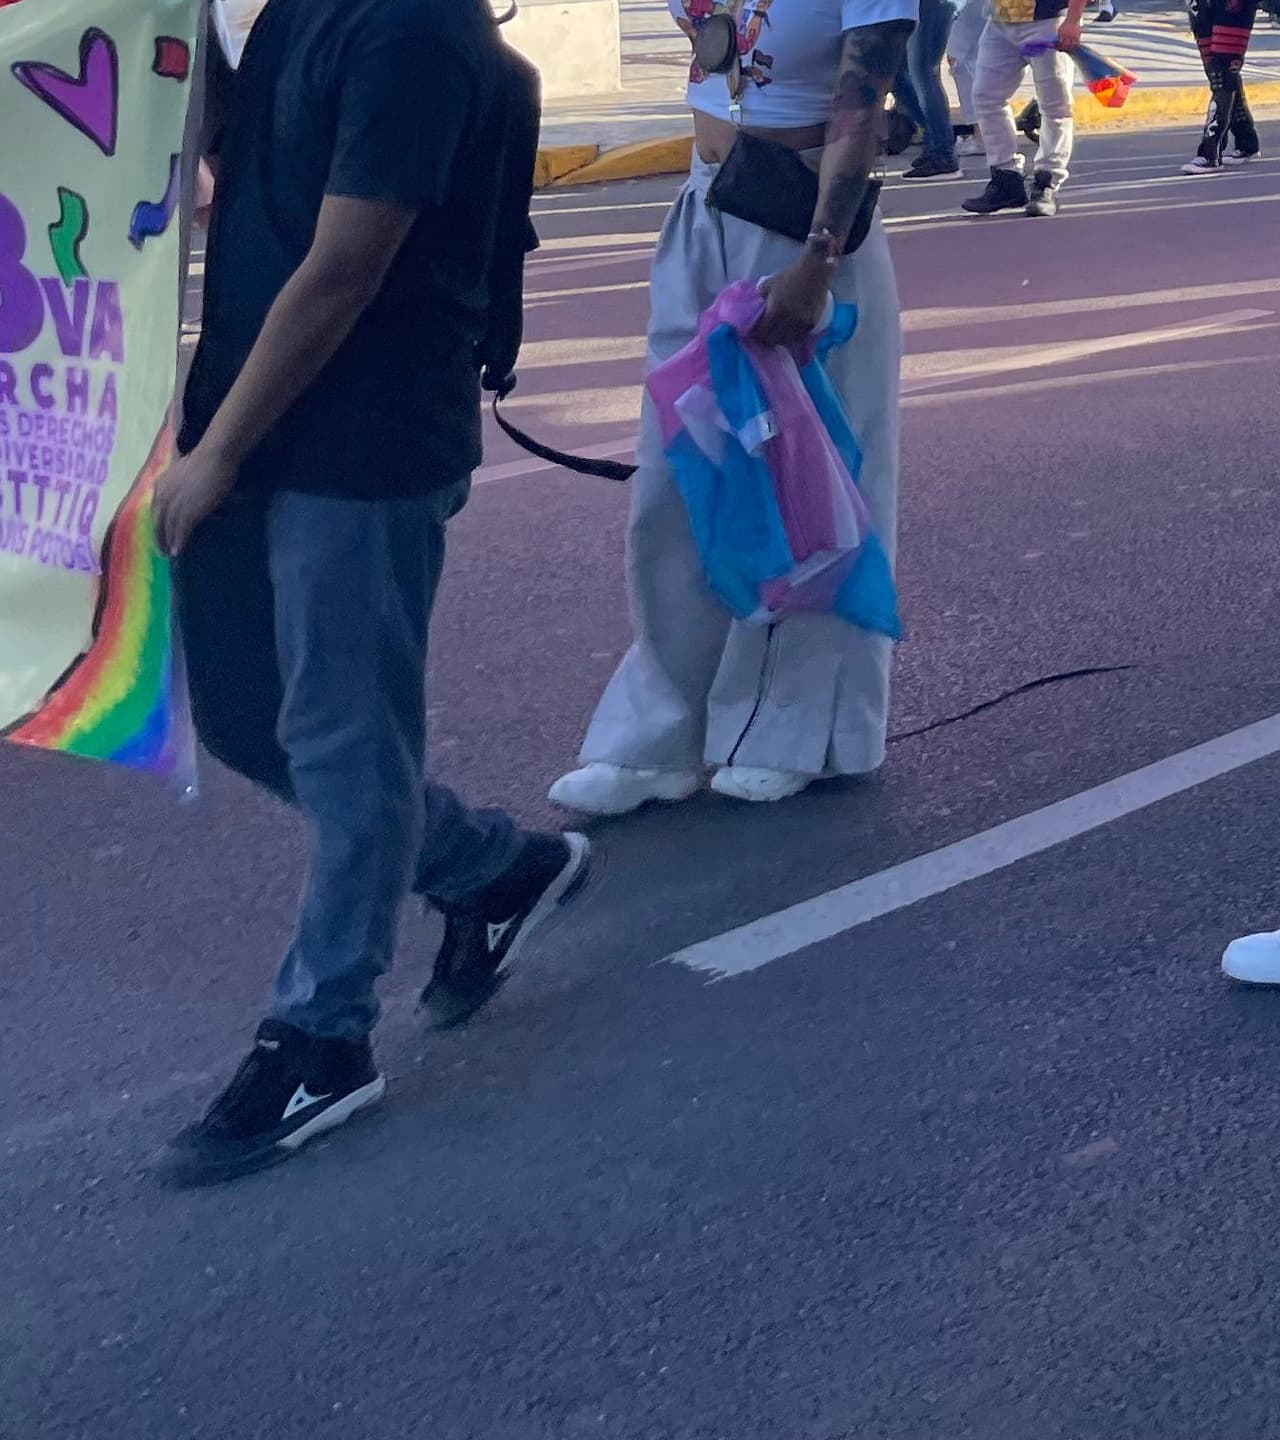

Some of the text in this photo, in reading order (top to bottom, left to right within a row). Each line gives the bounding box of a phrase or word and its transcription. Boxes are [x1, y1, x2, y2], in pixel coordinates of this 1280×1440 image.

[18, 412, 116, 456] DERECHOS
[0, 438, 109, 487] IVERSIDAD
[0, 468, 100, 537] TTTIQ
